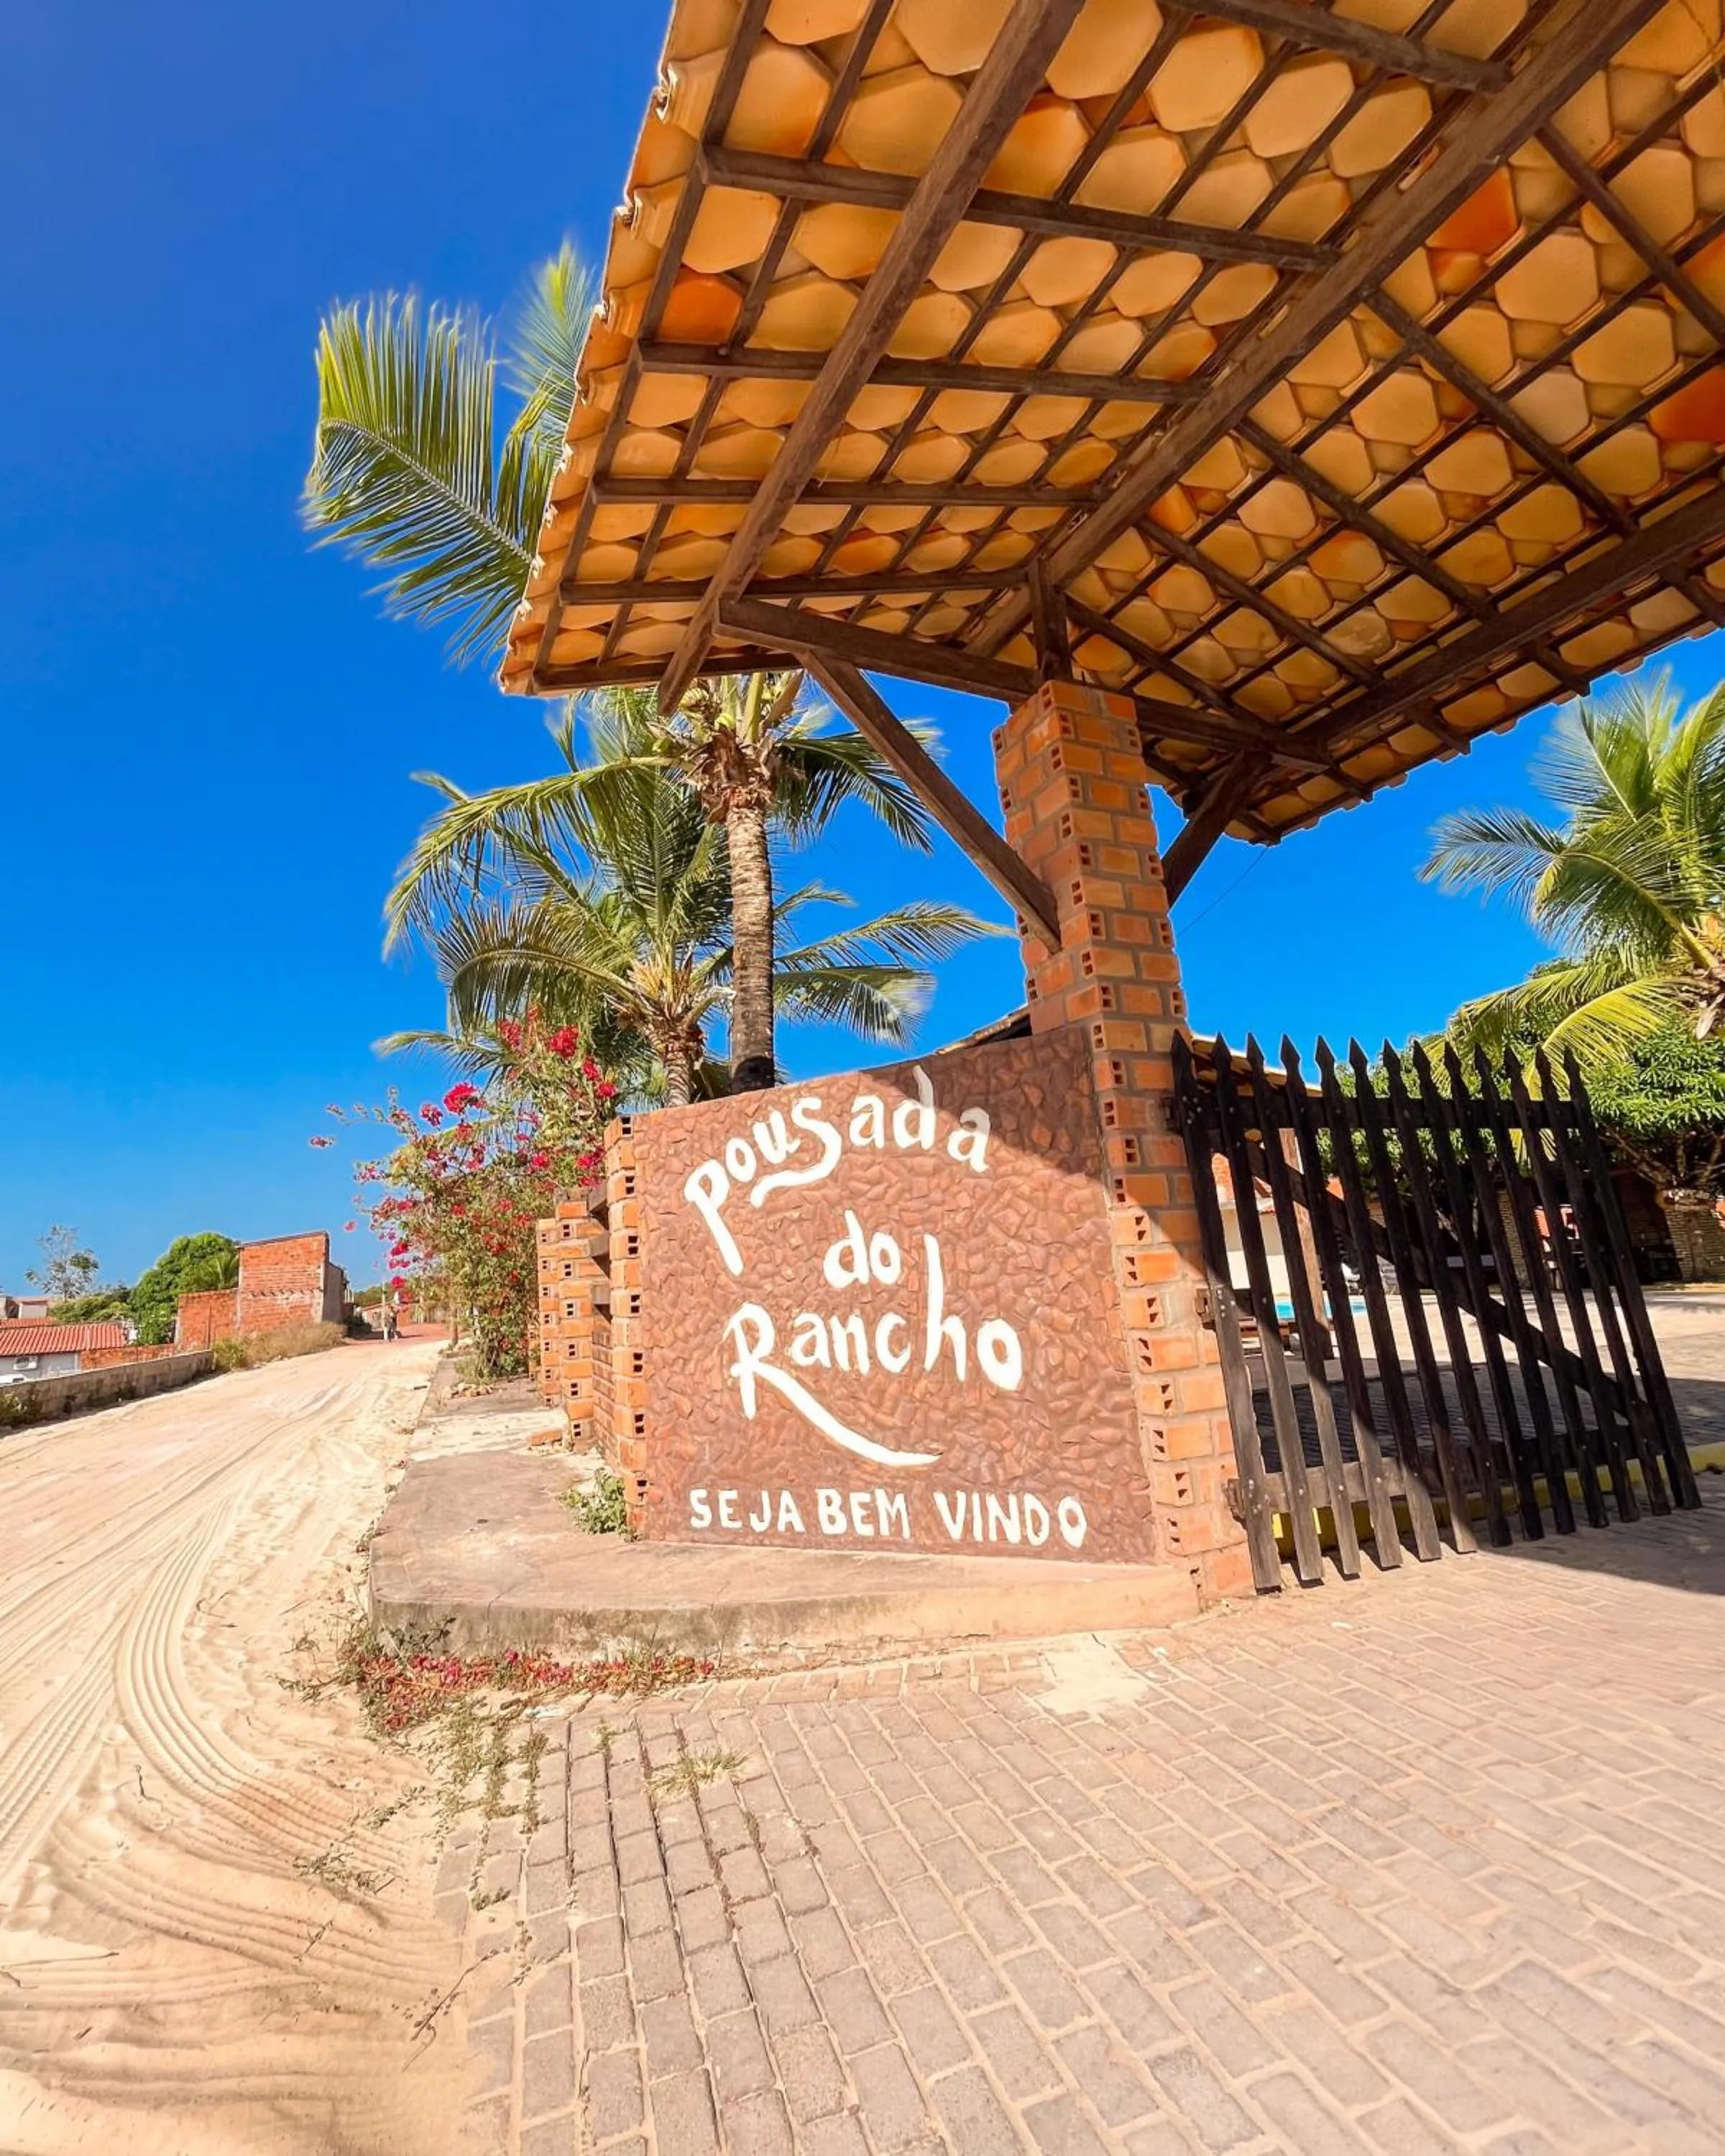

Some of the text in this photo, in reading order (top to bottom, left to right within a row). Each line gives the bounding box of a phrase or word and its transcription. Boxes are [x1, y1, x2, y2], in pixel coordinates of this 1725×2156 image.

[823, 1210, 902, 1289] do
[722, 1233, 1023, 1467] Rancho
[689, 1488, 1087, 1548] SEJA BEM VINDO
